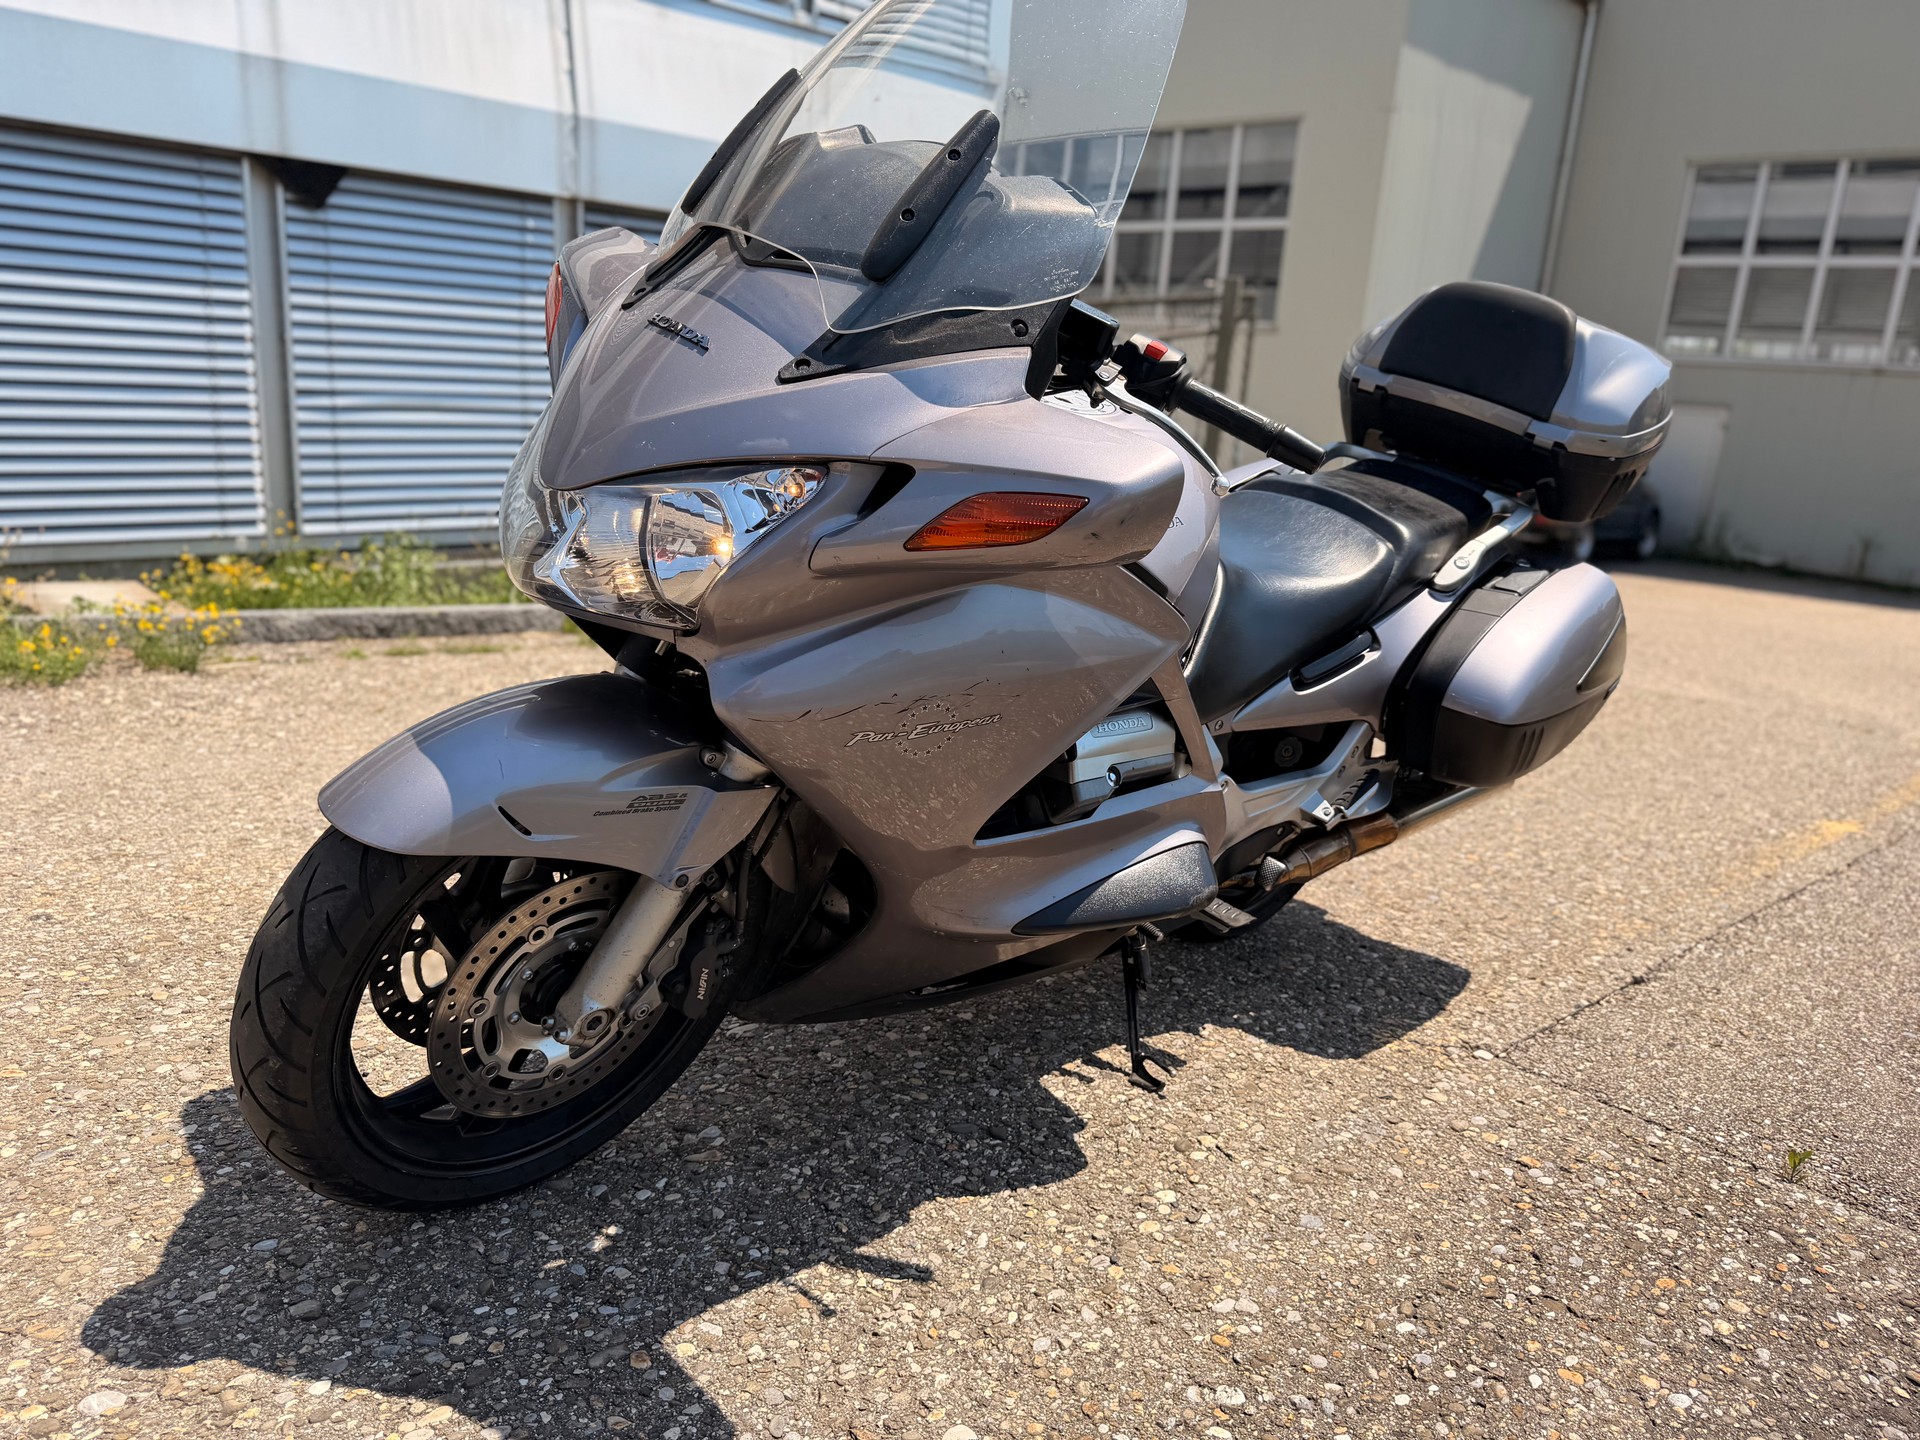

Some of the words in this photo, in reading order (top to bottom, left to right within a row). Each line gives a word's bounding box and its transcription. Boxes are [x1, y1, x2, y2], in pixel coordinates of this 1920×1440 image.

[648, 312, 710, 351] HONDA
[844, 713, 1003, 747] Pan-European
[1096, 716, 1147, 734] HONDA
[593, 809, 632, 817] Combined
